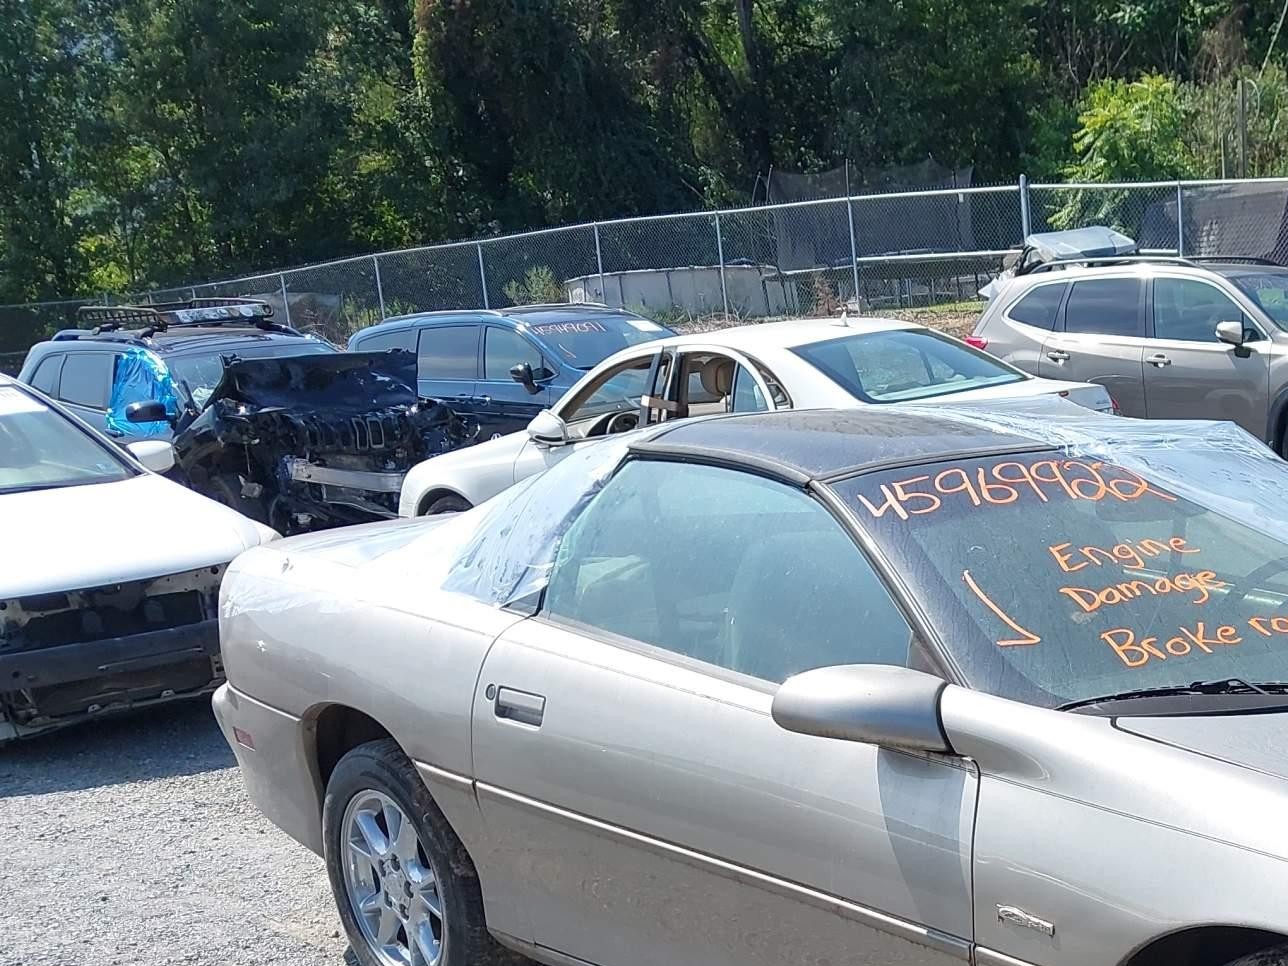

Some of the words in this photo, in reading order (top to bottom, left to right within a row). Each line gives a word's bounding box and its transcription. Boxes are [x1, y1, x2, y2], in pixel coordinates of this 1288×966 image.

[856, 459, 1178, 521] 45969922
[1048, 535, 1201, 573] Engine
[1058, 569, 1228, 614] Damage
[1100, 621, 1243, 668] Broke
